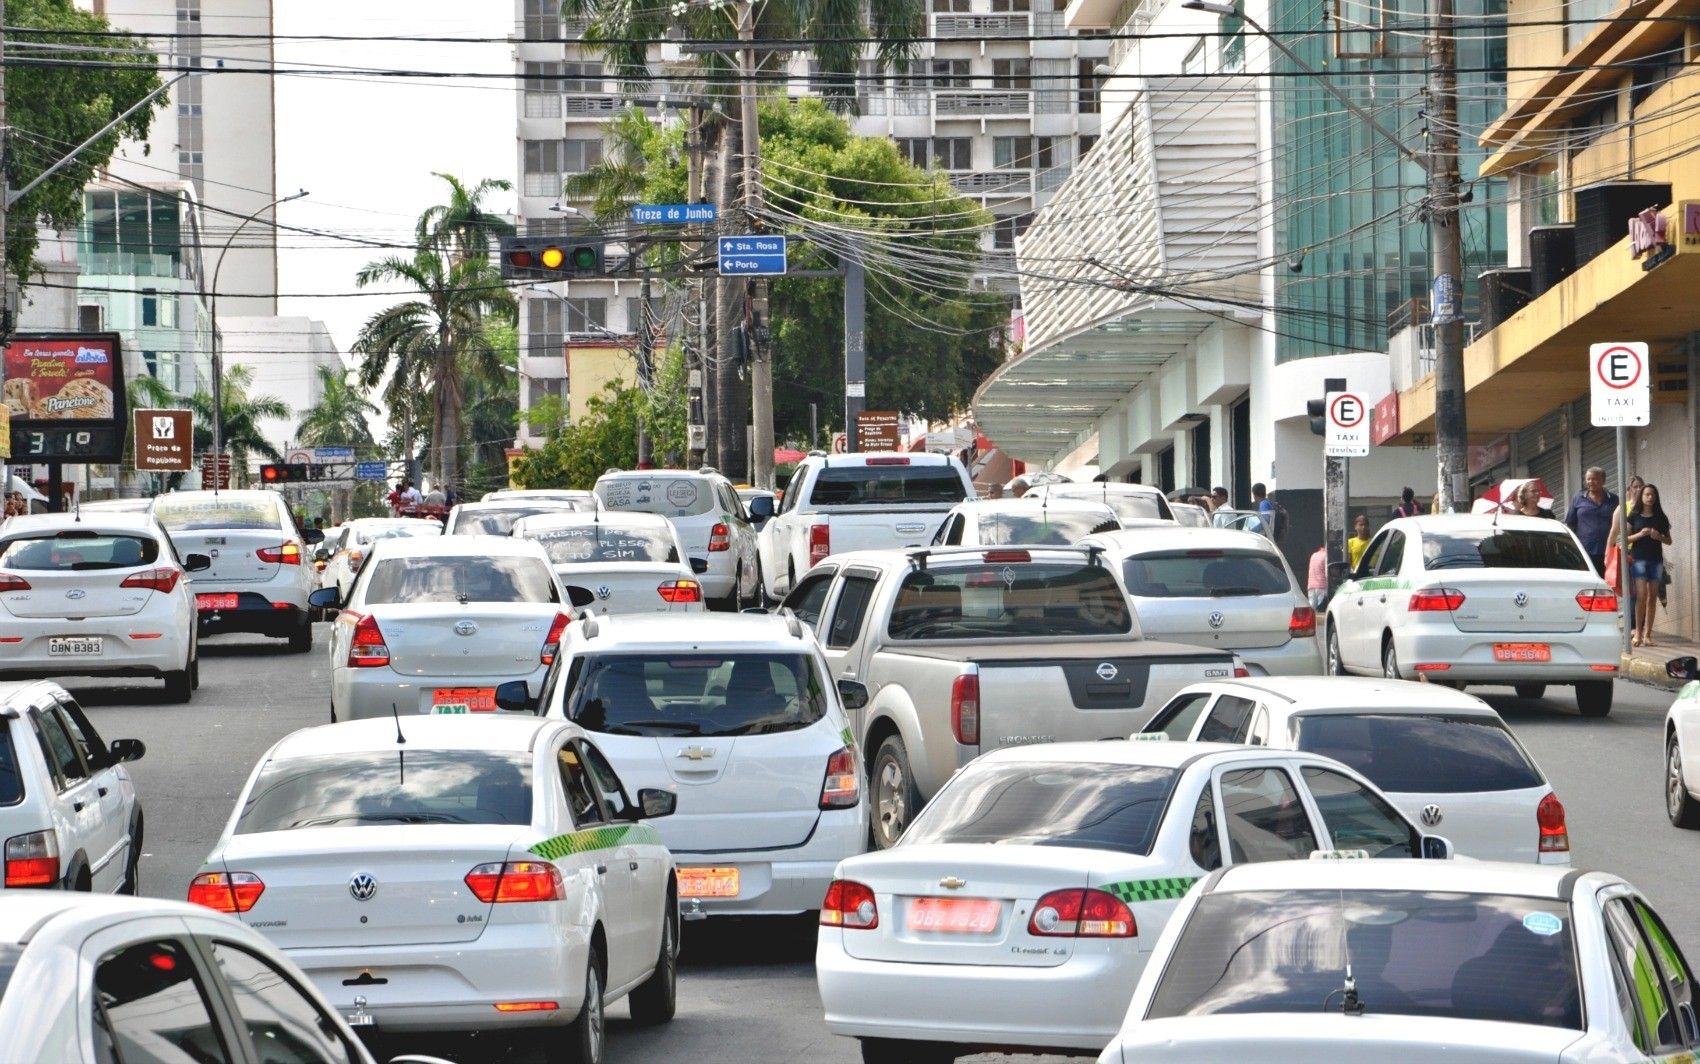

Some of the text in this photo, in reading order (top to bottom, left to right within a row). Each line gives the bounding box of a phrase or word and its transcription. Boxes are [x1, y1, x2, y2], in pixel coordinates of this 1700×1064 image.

[635, 207, 713, 220] Treze de Junho
[736, 242, 778, 250] Sta. Rosa
[735, 260, 758, 269] Porto
[1610, 354, 1629, 381] E
[47, 396, 96, 413] Panetone
[1607, 398, 1634, 406] TAXI
[1340, 400, 1355, 421] E
[607, 499, 630, 507] CASA
[602, 550, 635, 558] SIM
[436, 705, 466, 714] TAXI
